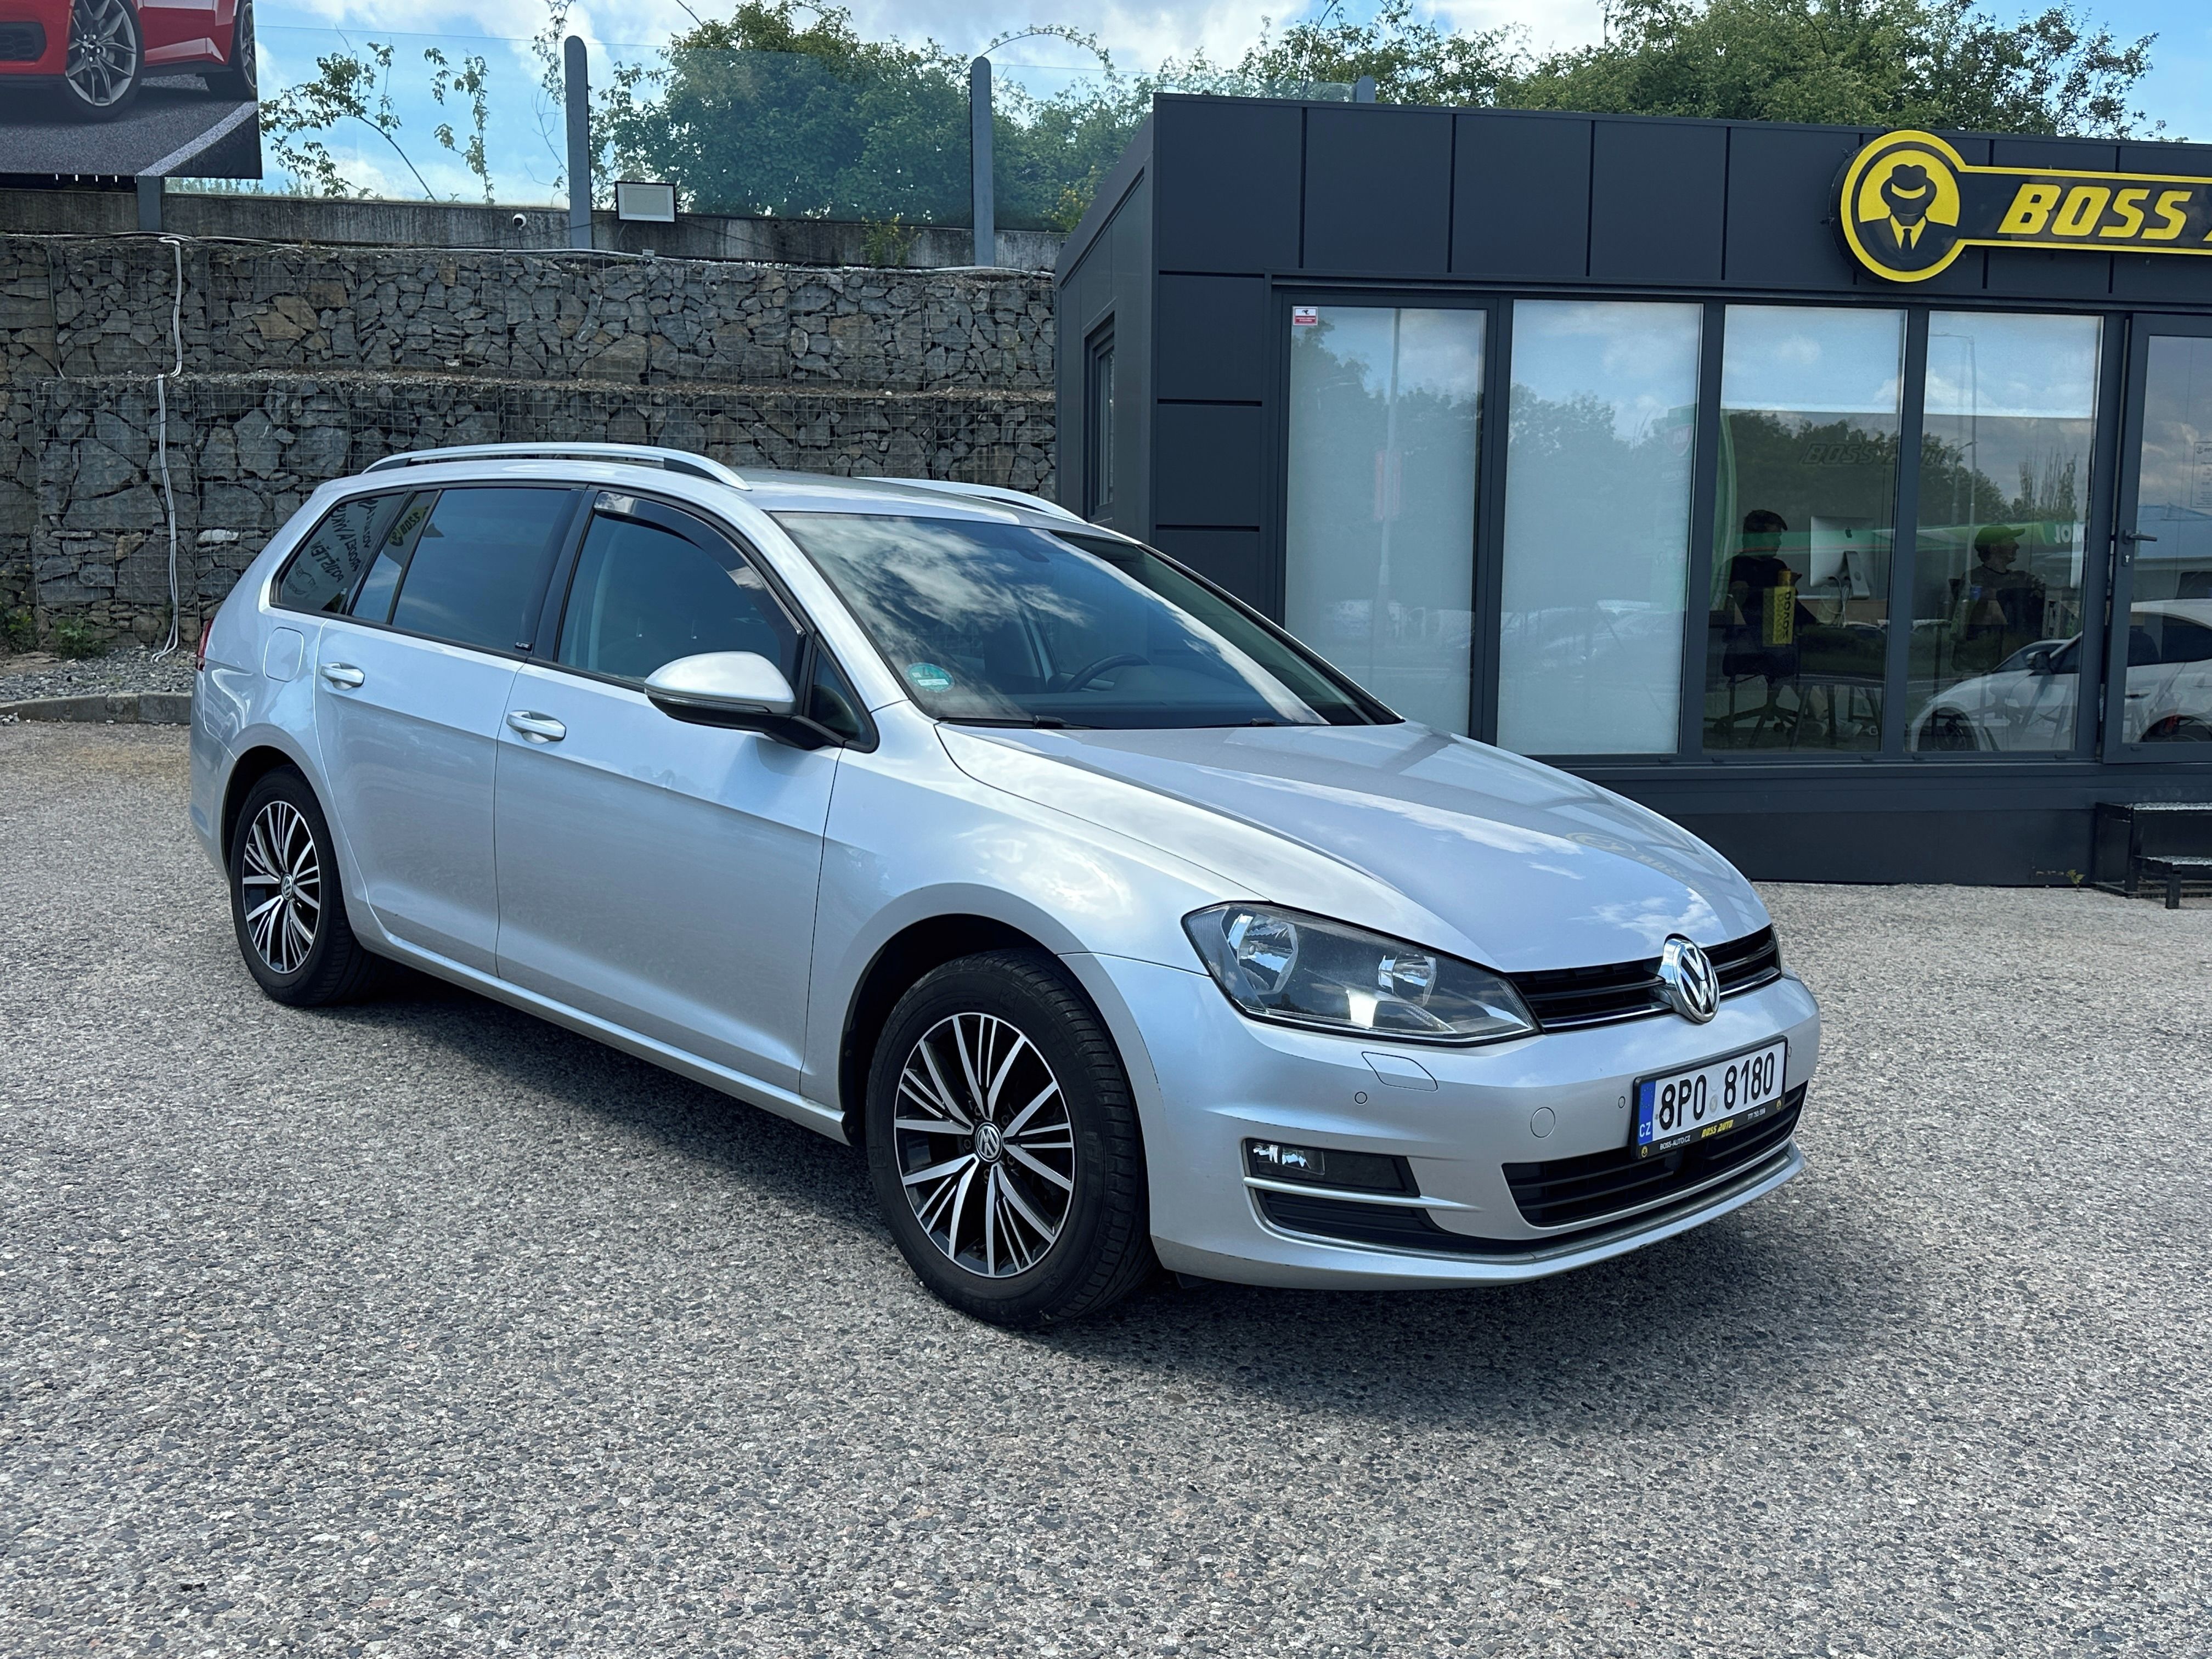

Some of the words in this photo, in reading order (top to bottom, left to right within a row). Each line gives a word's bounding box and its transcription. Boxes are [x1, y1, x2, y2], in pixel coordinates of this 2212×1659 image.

[1997, 184, 2193, 240] BOSS
[1802, 443, 1877, 465] BOSS
[1659, 1074, 1707, 1130] 8P0
[1724, 1052, 1775, 1110] 8180
[1639, 1121, 1651, 1138] CZ
[1701, 1125, 1718, 1138] BOSS
[1717, 1119, 1734, 1133] AUTO
